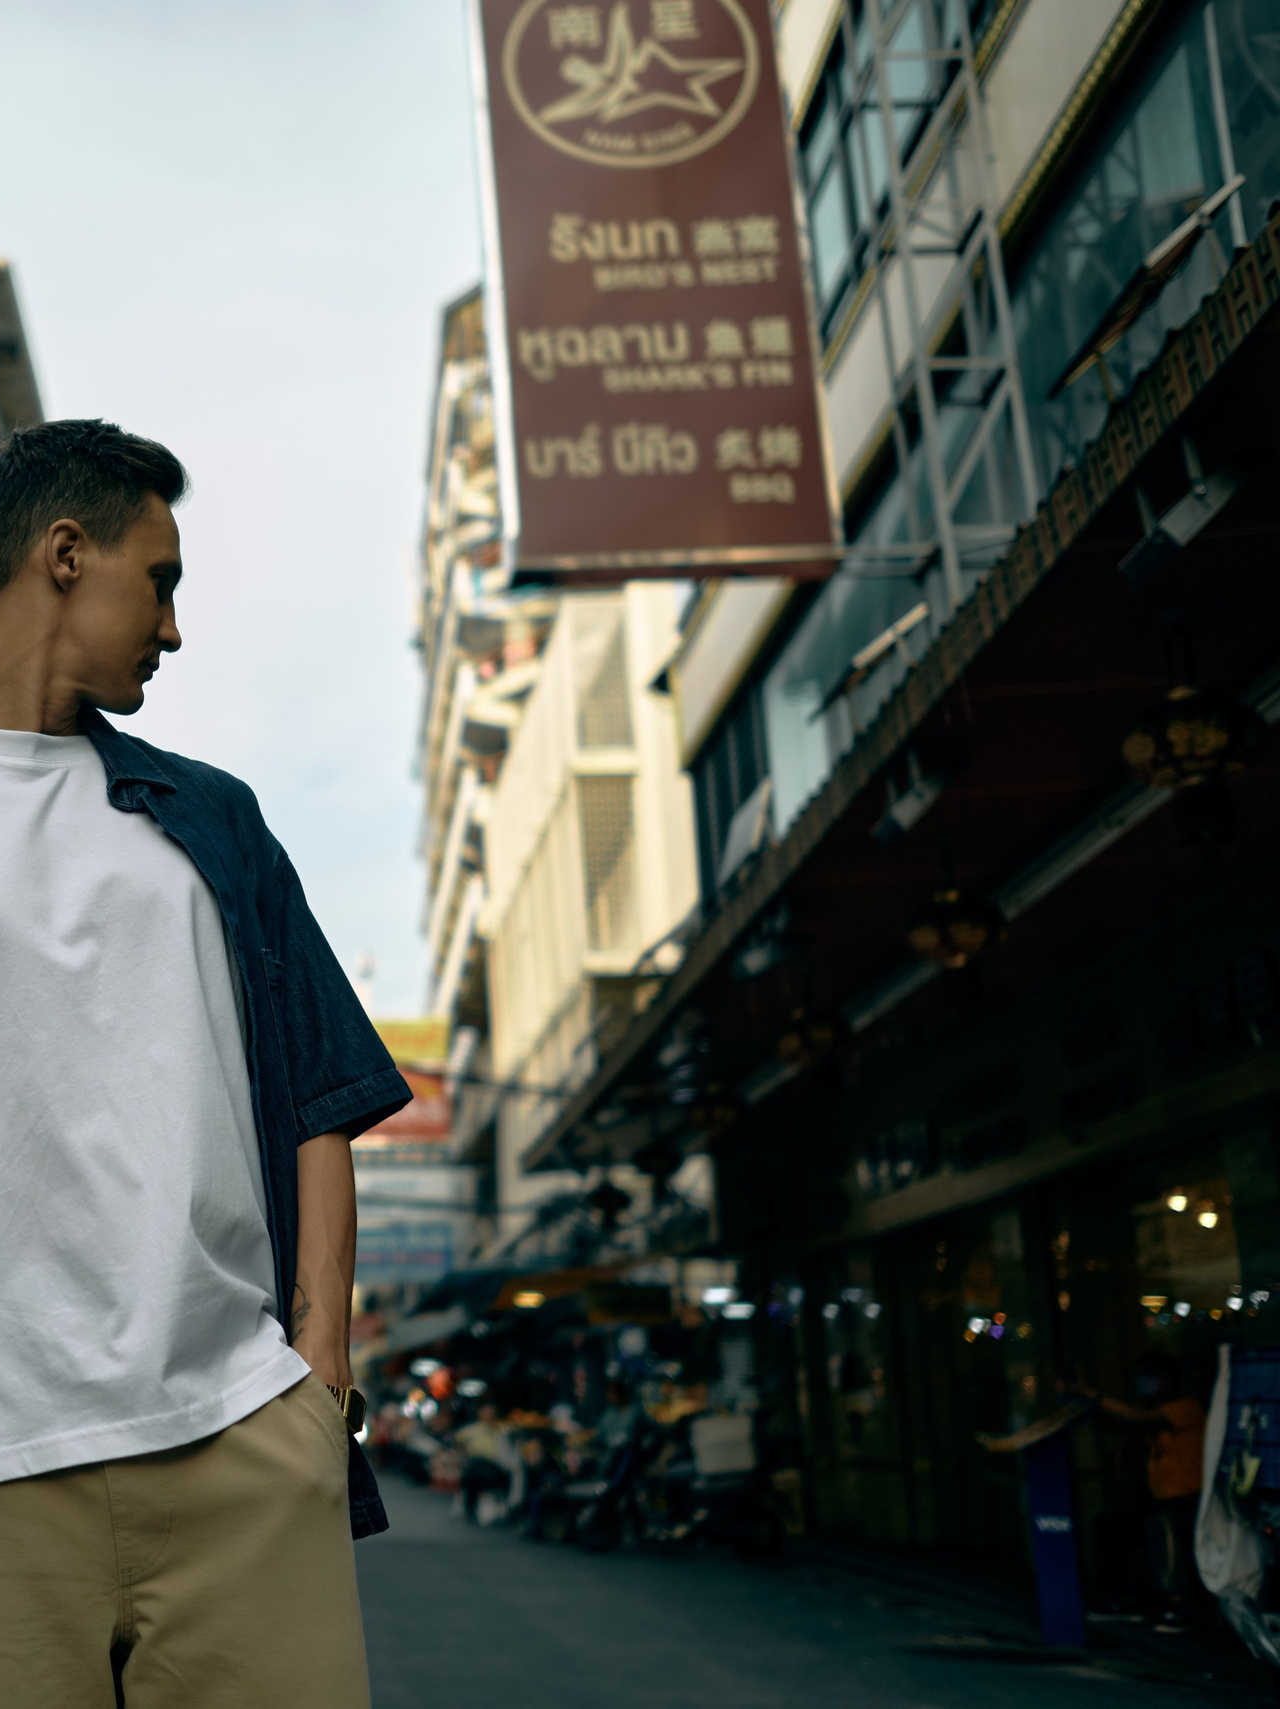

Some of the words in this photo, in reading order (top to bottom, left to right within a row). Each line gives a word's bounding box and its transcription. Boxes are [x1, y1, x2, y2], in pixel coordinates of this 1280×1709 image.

[702, 258, 775, 285] NEST
[604, 364, 734, 391] SHARK'S
[742, 360, 791, 386] FIN
[731, 474, 794, 502] BBQ
